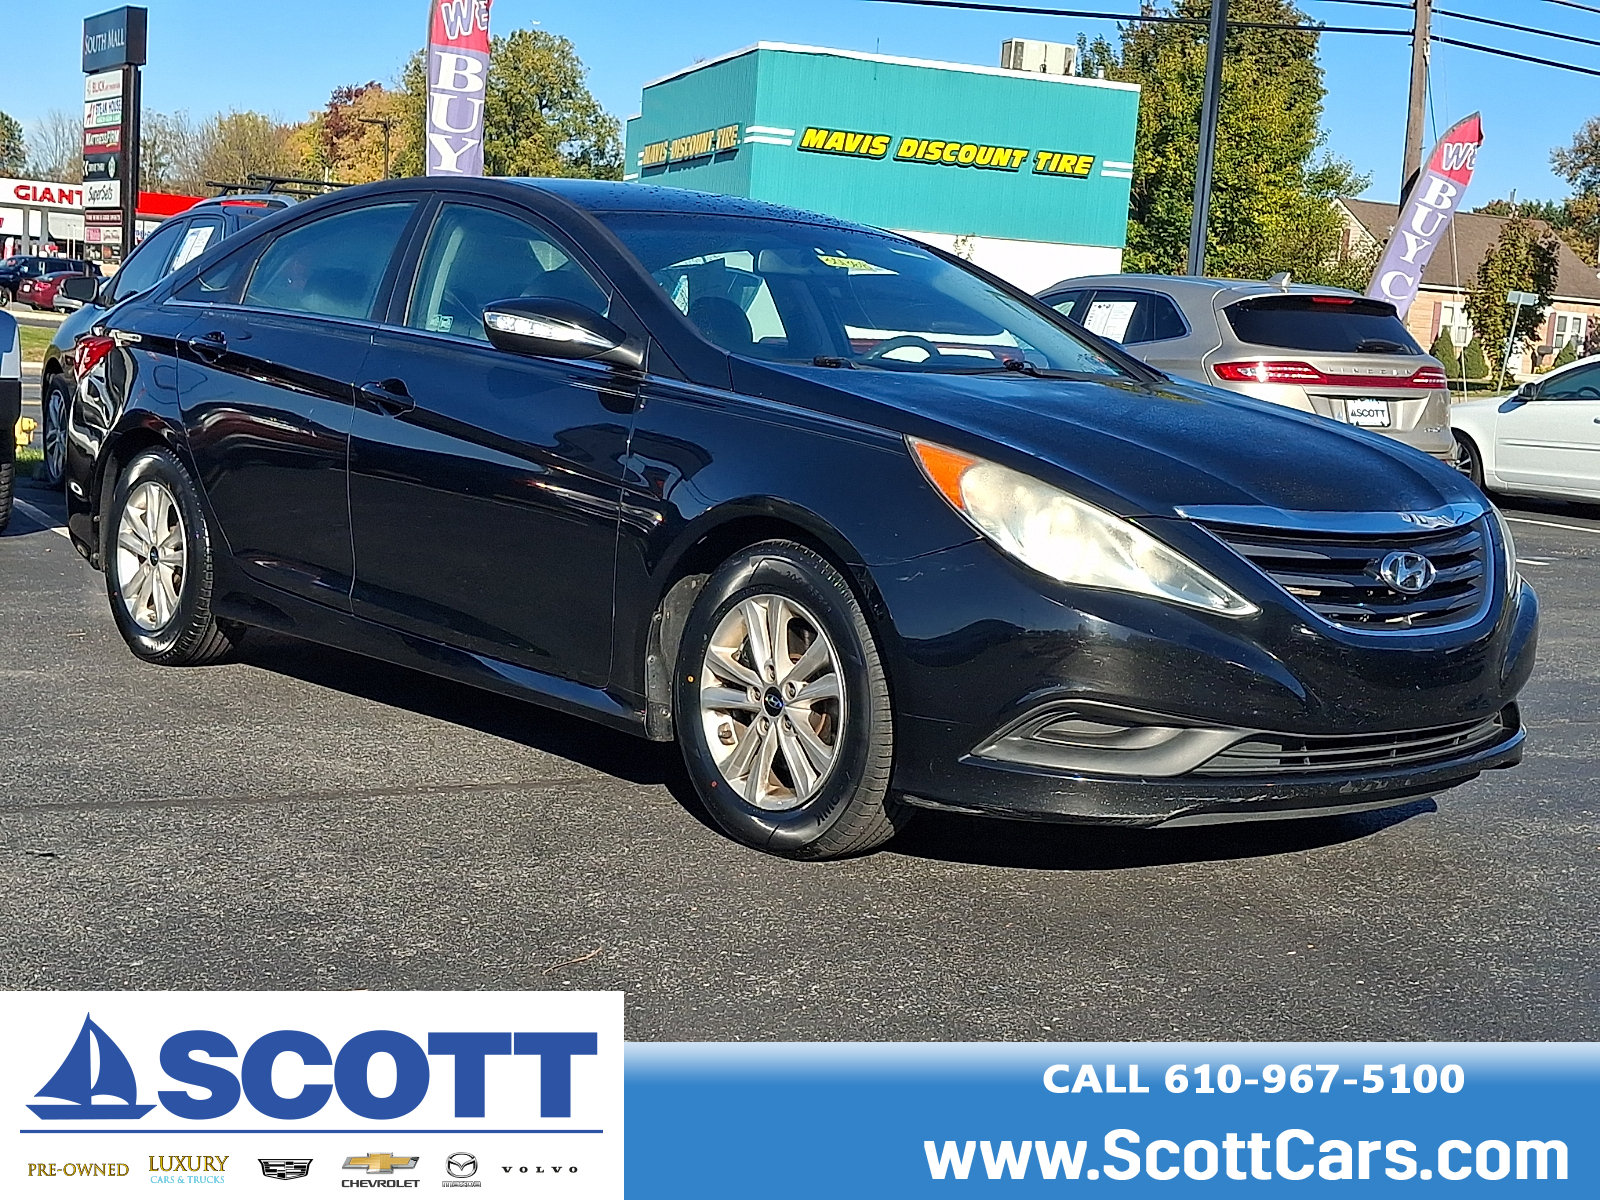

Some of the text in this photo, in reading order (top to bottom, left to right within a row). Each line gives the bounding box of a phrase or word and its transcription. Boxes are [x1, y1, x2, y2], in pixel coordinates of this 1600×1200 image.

[441, 0, 490, 41] WE
[84, 28, 124, 55] SOUTH MALL
[428, 51, 485, 173] BUY
[642, 124, 739, 165] MAVIS DISCOUNT TIRE
[800, 128, 1095, 176] MAVIS DISCOUNT TIRE
[14, 184, 83, 206] GIANT
[1399, 175, 1458, 265] BUY
[1356, 408, 1386, 418] SCOTT
